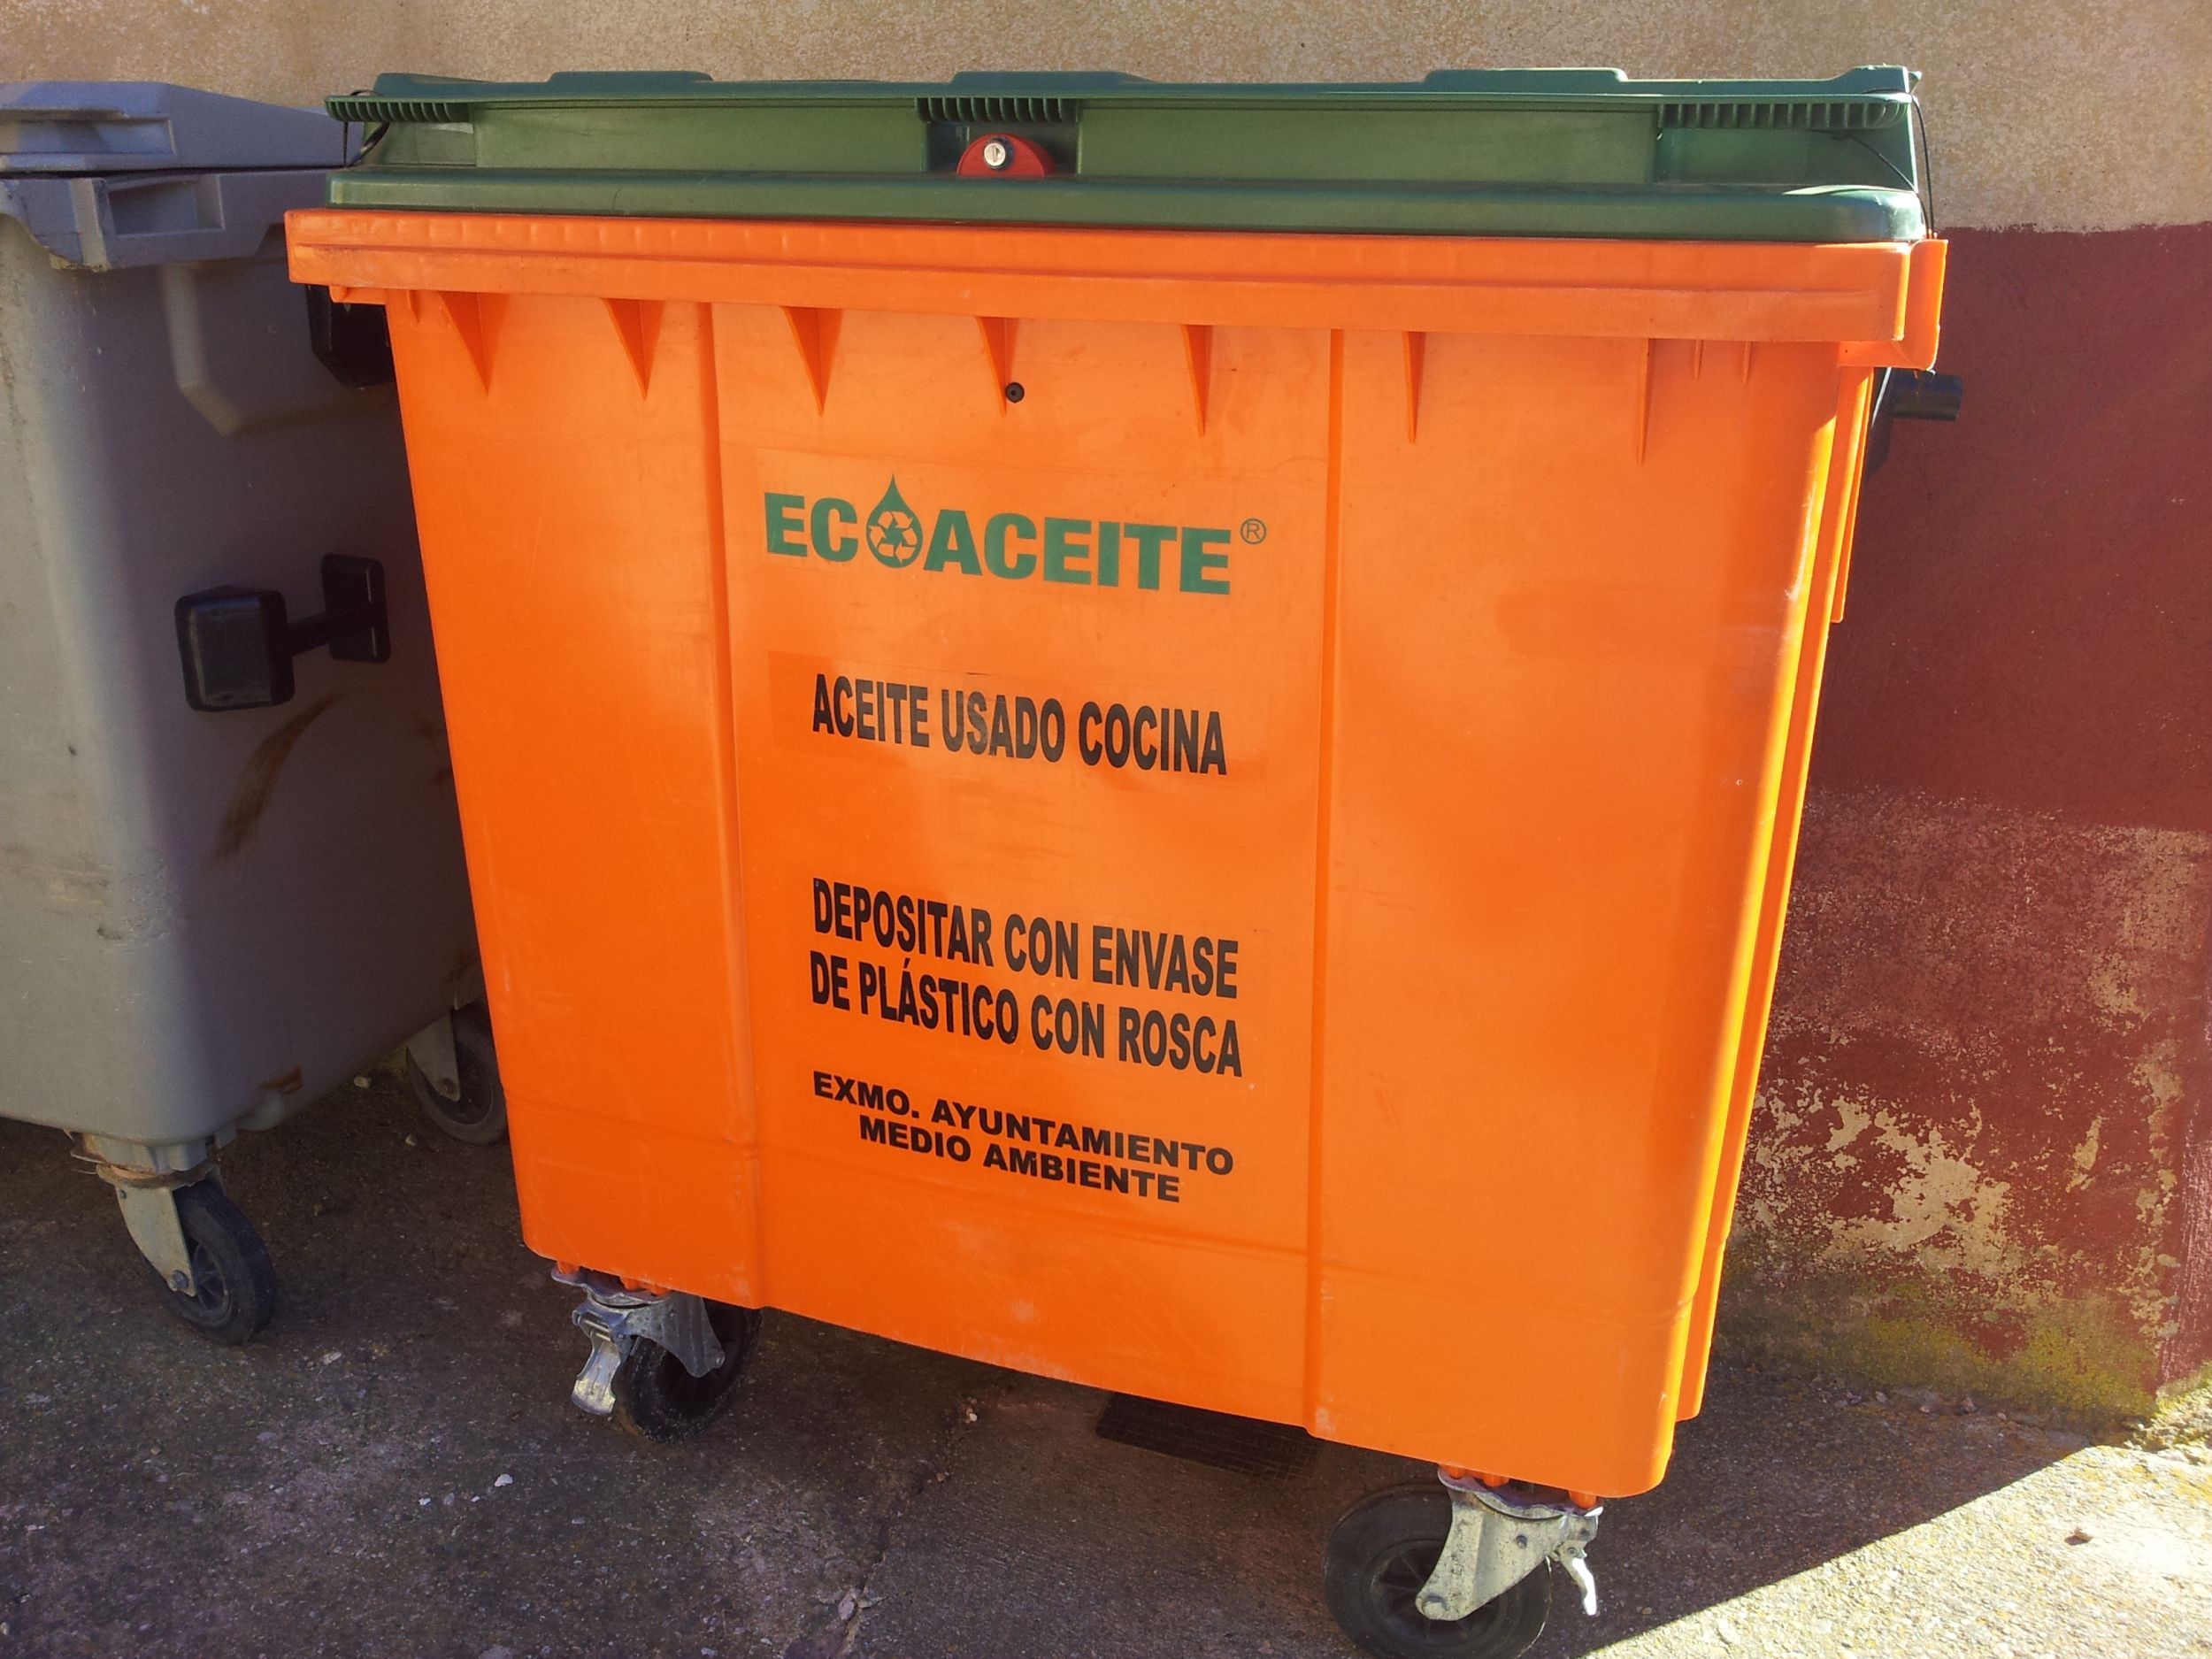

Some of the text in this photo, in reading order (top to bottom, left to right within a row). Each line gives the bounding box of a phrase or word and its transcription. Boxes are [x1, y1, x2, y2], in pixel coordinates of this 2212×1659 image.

[812, 673, 1227, 775] ACEITE USADO COCINA
[813, 878, 1239, 999] DEPOSITAR CON ENVASE
[810, 950, 1242, 1078] DE PLÁSTICO CON ROSCA
[813, 1071, 1233, 1176] EXMO. AYUNTAMIENTO
[859, 1115, 1180, 1202] MEDIO AMBIENTE
